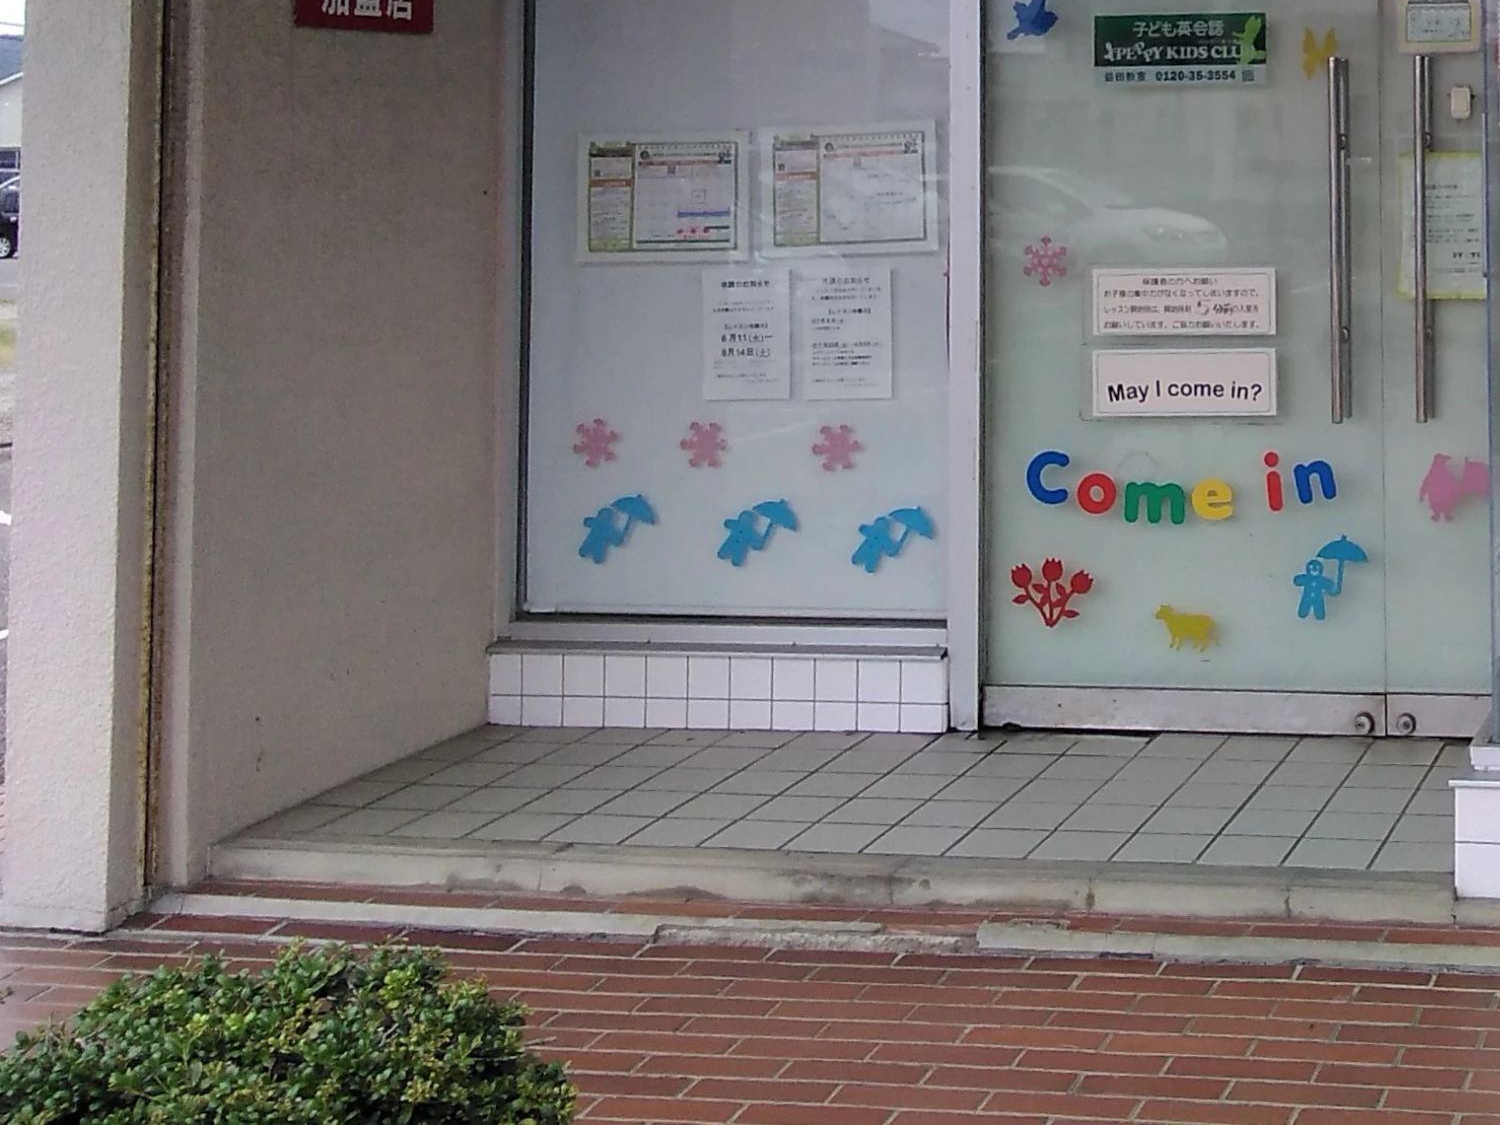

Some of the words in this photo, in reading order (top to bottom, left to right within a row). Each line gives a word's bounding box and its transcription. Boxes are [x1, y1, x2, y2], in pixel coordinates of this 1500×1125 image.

[1133, 20, 1224, 38] 子ども英会話
[1166, 46, 1208, 60] KIDS
[1210, 45, 1245, 59] CLU
[1155, 70, 1236, 81] 0120-35-3554
[1107, 383, 1149, 404] May
[1155, 380, 1161, 397] I
[1167, 383, 1224, 397] come
[1231, 381, 1262, 401] in?
[1026, 450, 1234, 525] Come
[1264, 451, 1337, 512] in
